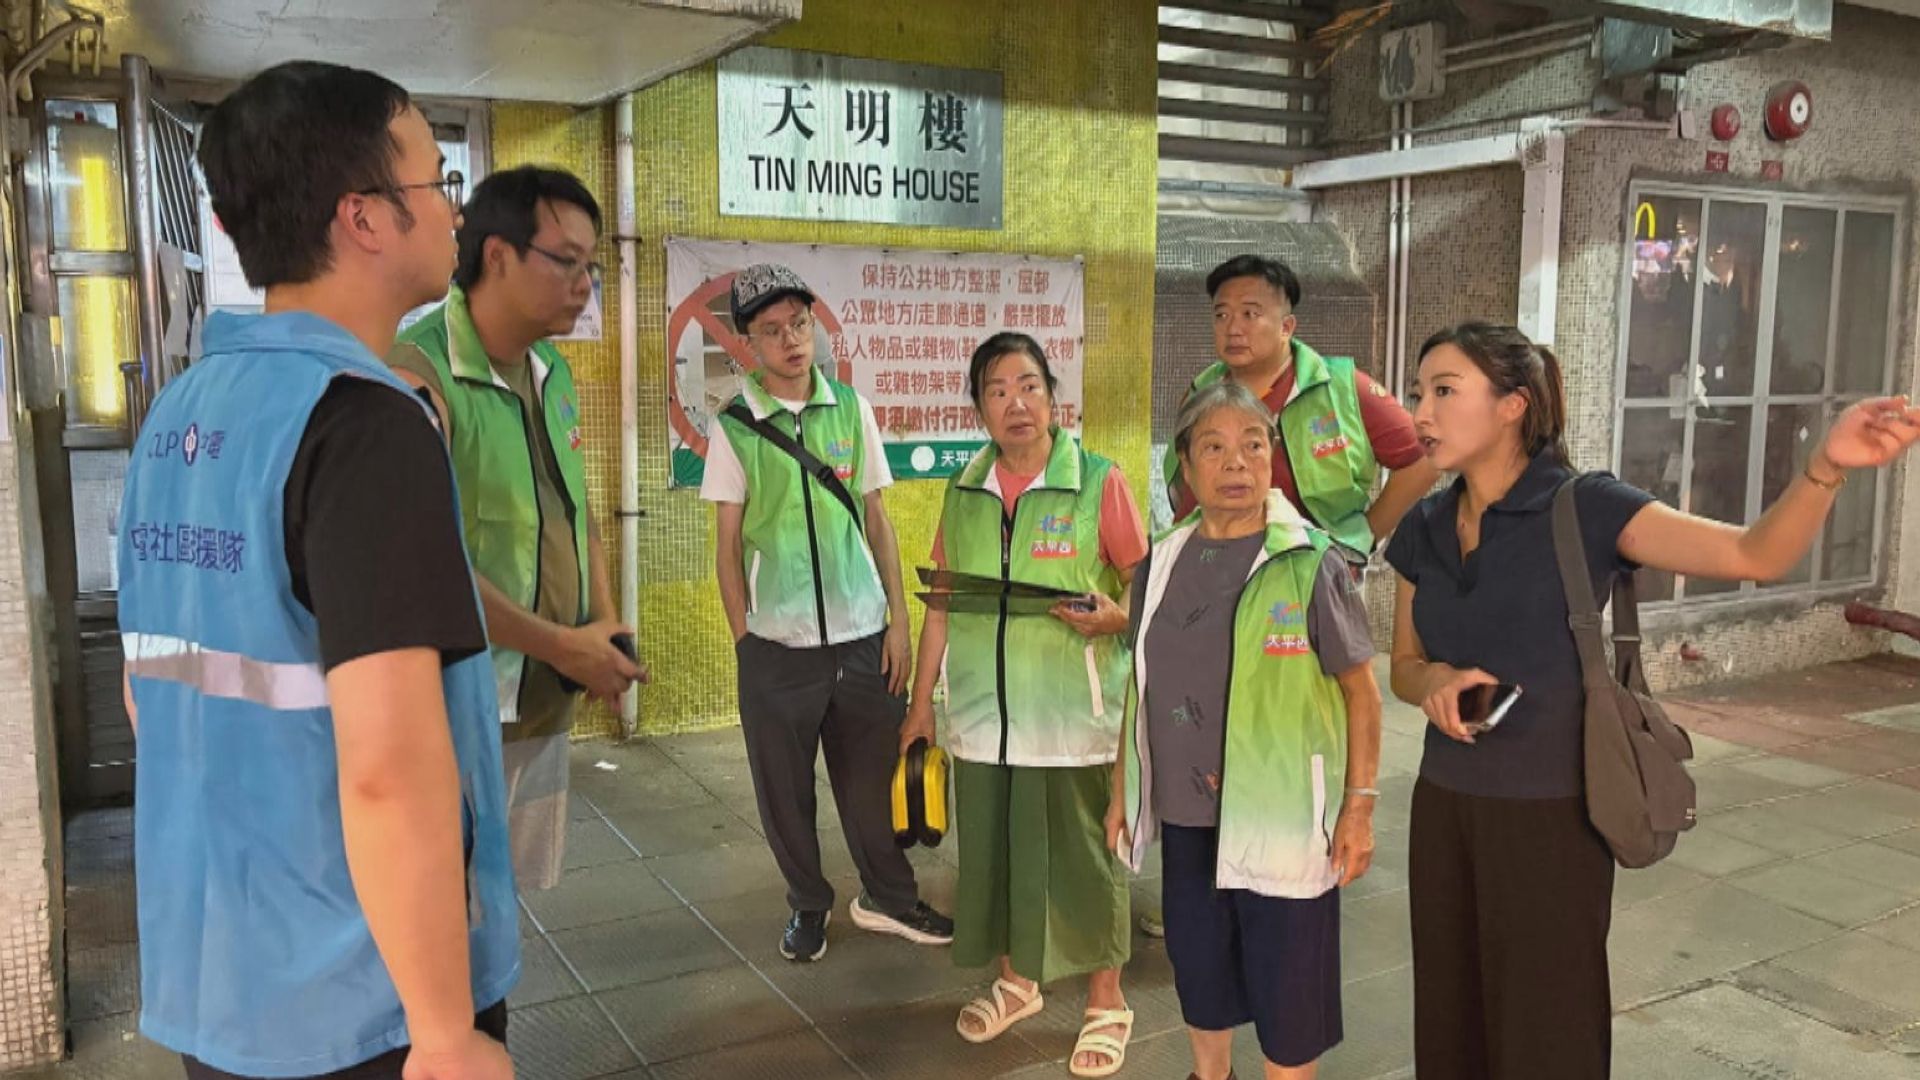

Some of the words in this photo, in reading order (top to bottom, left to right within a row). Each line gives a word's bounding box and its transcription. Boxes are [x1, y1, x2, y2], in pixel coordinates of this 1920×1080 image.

[762, 82, 969, 153] 天明樓
[748, 155, 796, 192] TIN
[807, 160, 882, 197] MING
[893, 165, 980, 203] HOUSE
[148, 430, 179, 459] LP
